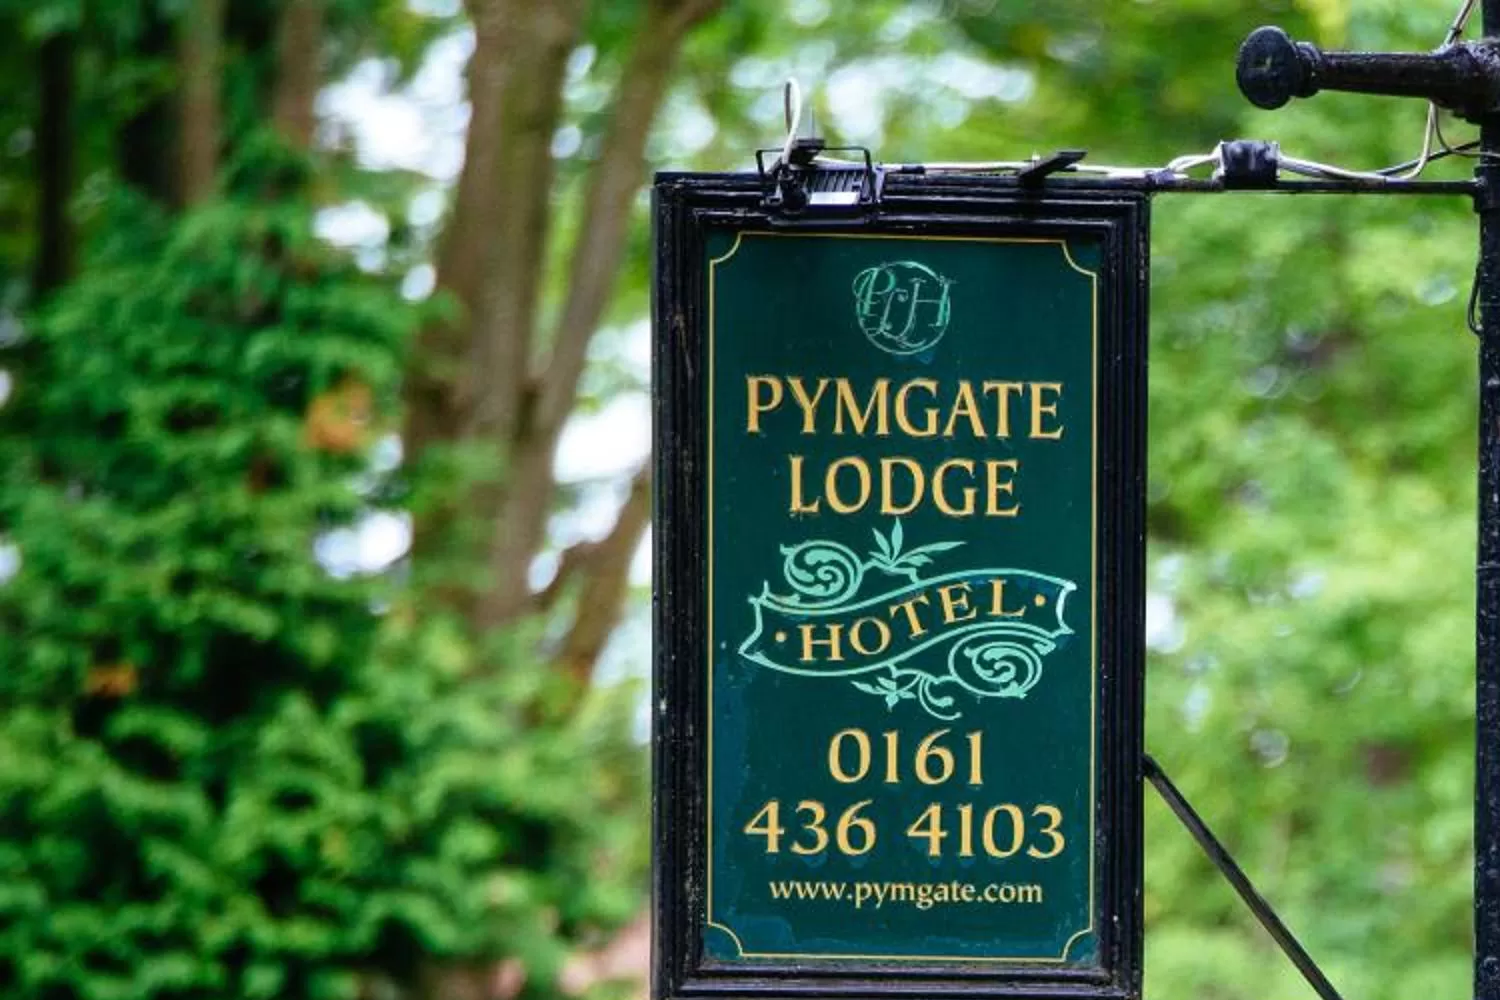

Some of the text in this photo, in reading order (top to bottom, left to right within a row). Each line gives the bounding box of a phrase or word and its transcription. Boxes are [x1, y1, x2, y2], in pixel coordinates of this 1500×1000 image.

[745, 373, 1065, 441] PYMGATE
[788, 453, 1021, 519] LODGE
[798, 579, 1026, 662] HOTEL
[828, 727, 984, 785] 0161
[743, 799, 1066, 859] 436 4103
[769, 879, 1043, 910] www.pymgate.com
